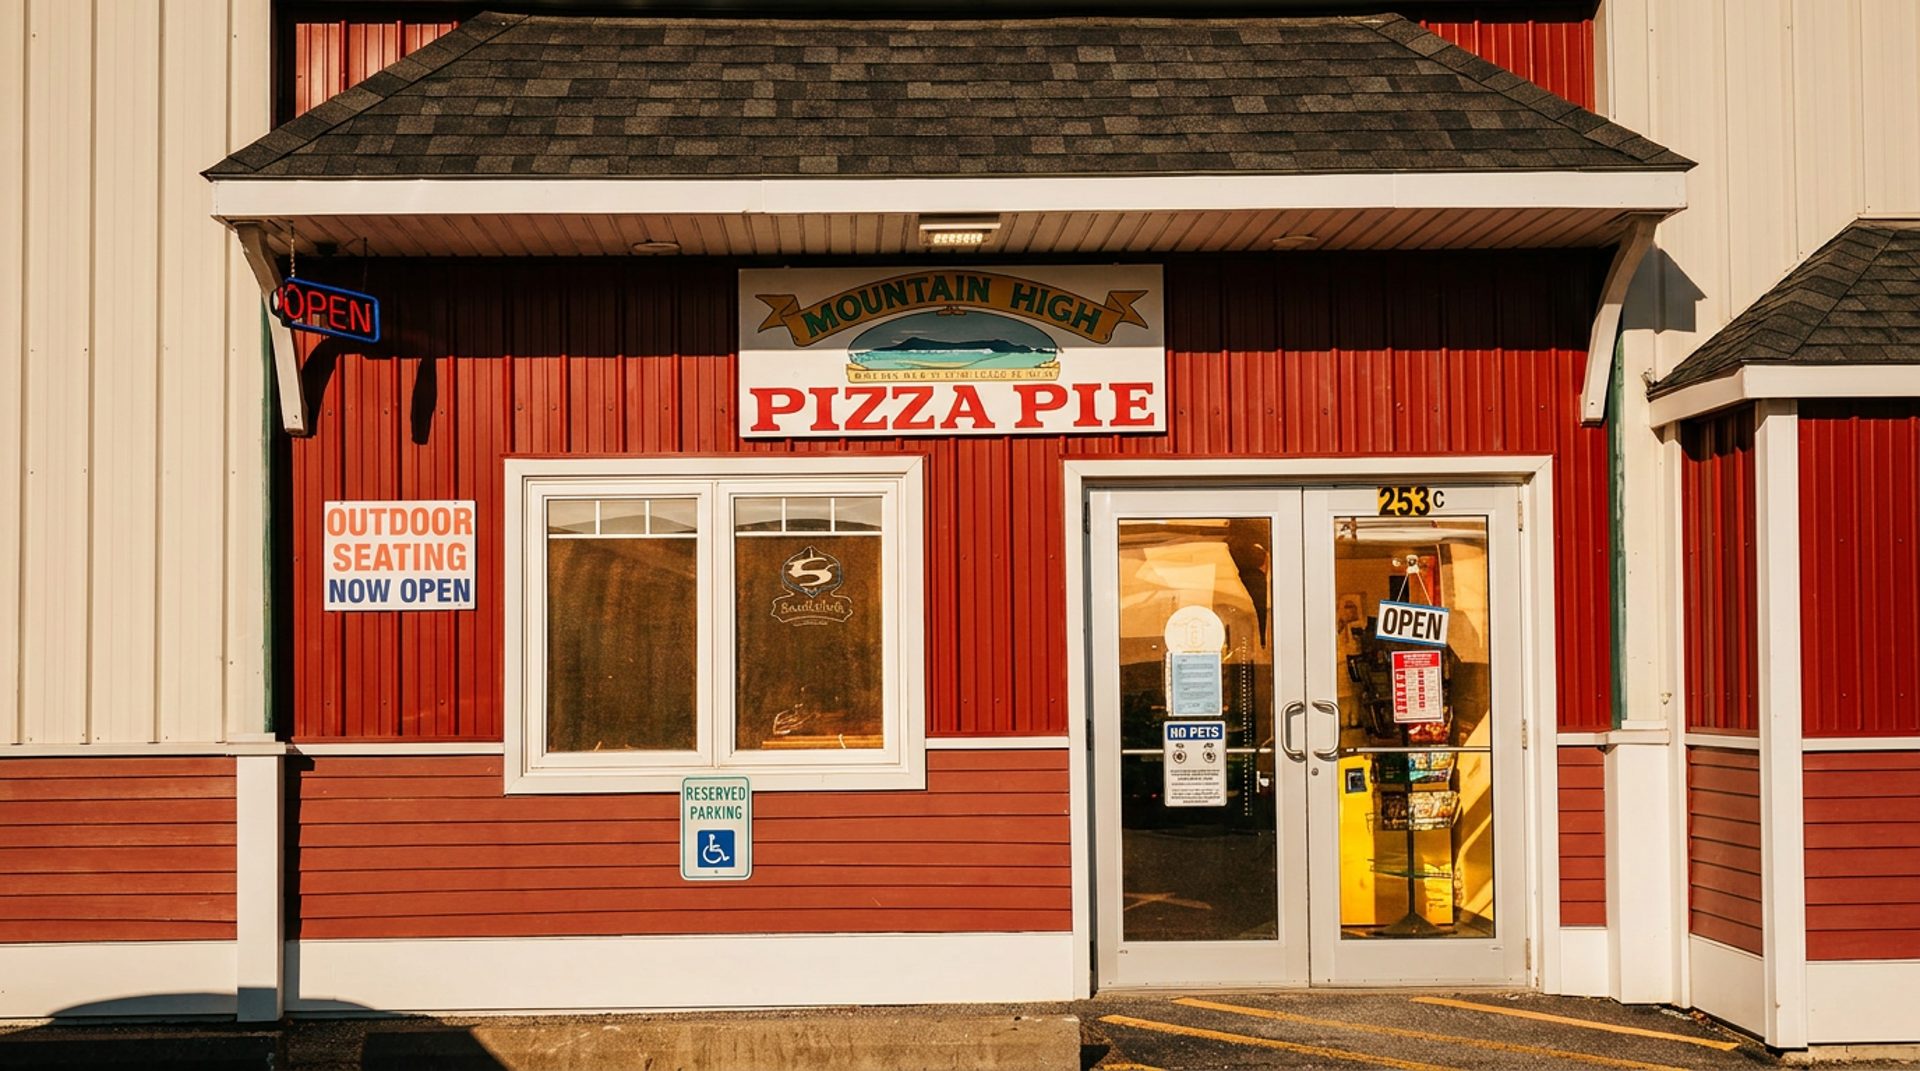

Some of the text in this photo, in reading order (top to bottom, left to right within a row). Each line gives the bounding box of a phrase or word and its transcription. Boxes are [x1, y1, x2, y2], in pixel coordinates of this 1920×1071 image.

[282, 284, 371, 333] OPEN
[802, 275, 1102, 338] MOUNTAIN HIGH
[750, 383, 1155, 432] PIZZA PIE
[1379, 486, 1430, 516] 253
[326, 507, 473, 537] OUTDOOR
[332, 542, 467, 572] SEATING
[329, 578, 471, 603] NOW OPEN
[1382, 607, 1444, 641] OPEN
[1190, 726, 1220, 738] PETS
[686, 786, 746, 801] RESERVED
[690, 805, 742, 820] PARKING
